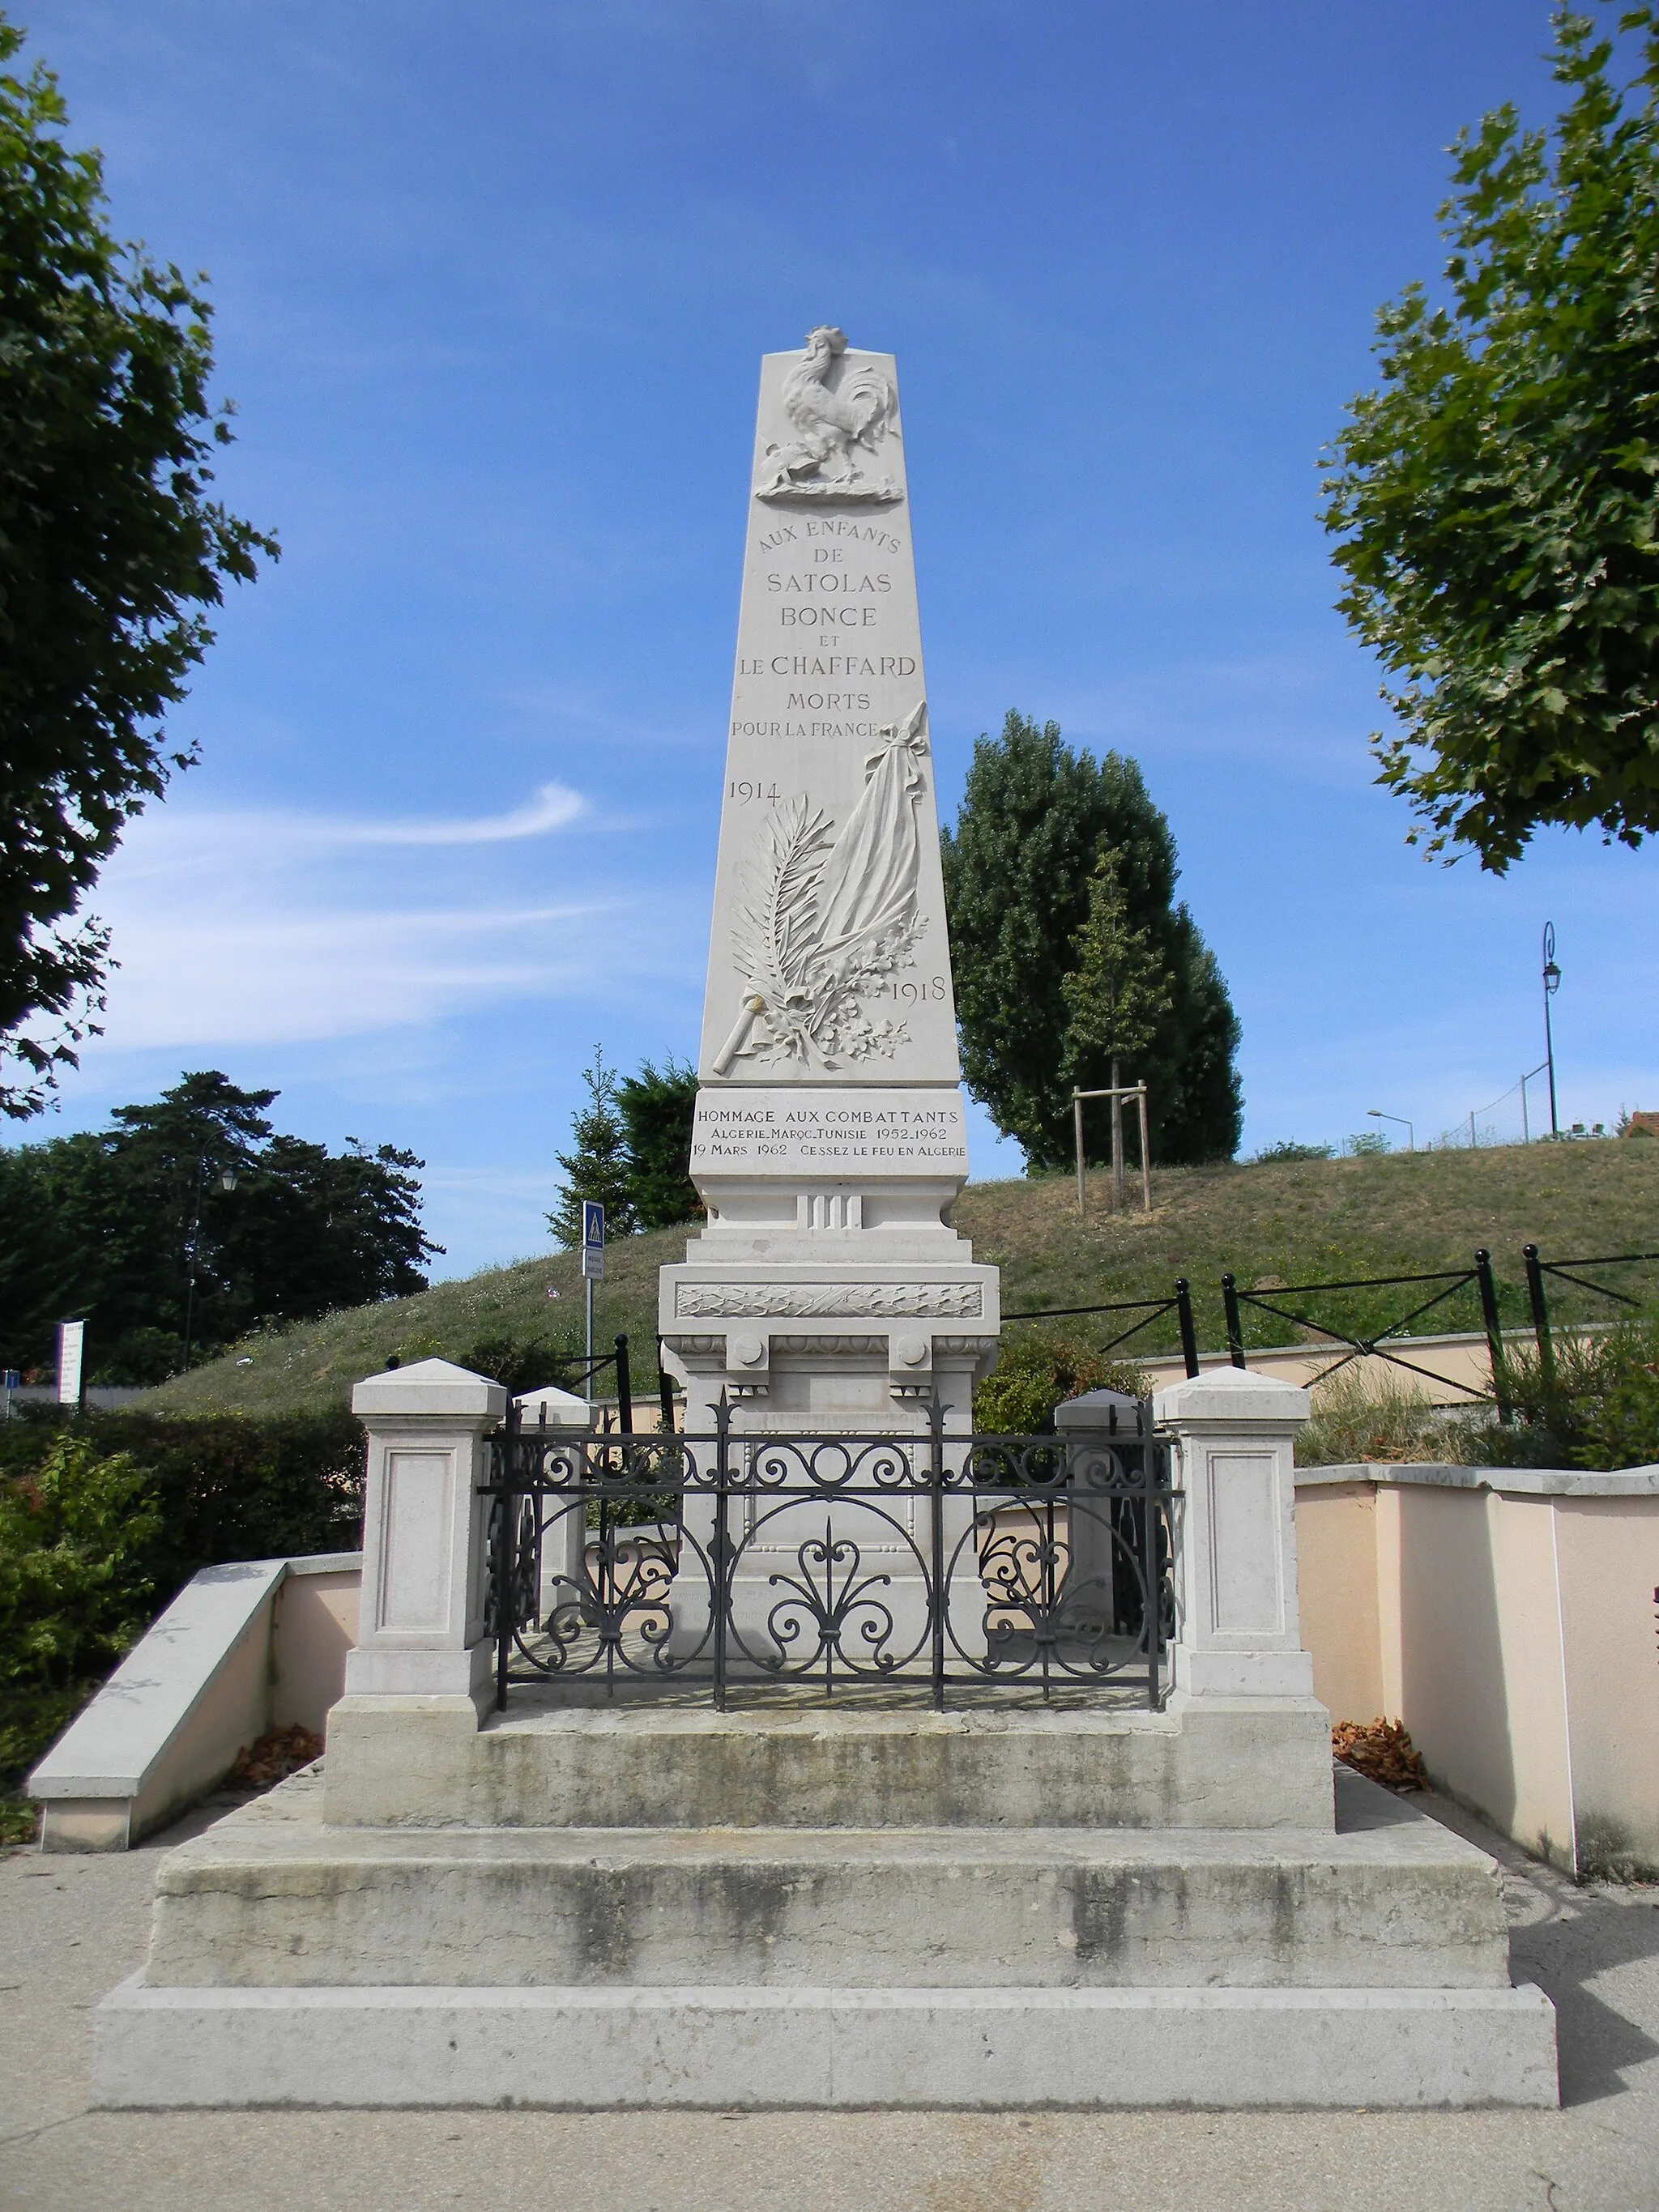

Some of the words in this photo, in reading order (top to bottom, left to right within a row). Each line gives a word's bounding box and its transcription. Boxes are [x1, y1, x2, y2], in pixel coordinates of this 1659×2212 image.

[759, 526, 799, 554] AUX
[807, 521, 902, 554] ENFANTS
[814, 548, 844, 563] DE
[767, 573, 892, 593] SATOLAS
[781, 607, 876, 626] BONCE
[820, 635, 840, 646] ET
[740, 659, 764, 675] LE
[771, 656, 916, 678] CHAFFARD
[787, 693, 871, 712] MORTS
[732, 722, 782, 739] POUR
[786, 722, 807, 736] LA
[811, 722, 878, 739] FRANCE
[730, 781, 781, 807] 1914
[893, 976, 946, 1007] 1918
[698, 1110, 775, 1123] HOMMAGE
[785, 1111, 820, 1123] AUX
[825, 1110, 958, 1123] COMBATTANTS
[693, 1144, 706, 1158] 19
[710, 1144, 748, 1156] MARS
[757, 1144, 787, 1157] 1962
[800, 1144, 849, 1156] CESSEZ
[853, 1147, 868, 1156] LE
[872, 1147, 894, 1156] FEU
[898, 1147, 915, 1156] EN
[917, 1146, 966, 1157] ALGERIE
